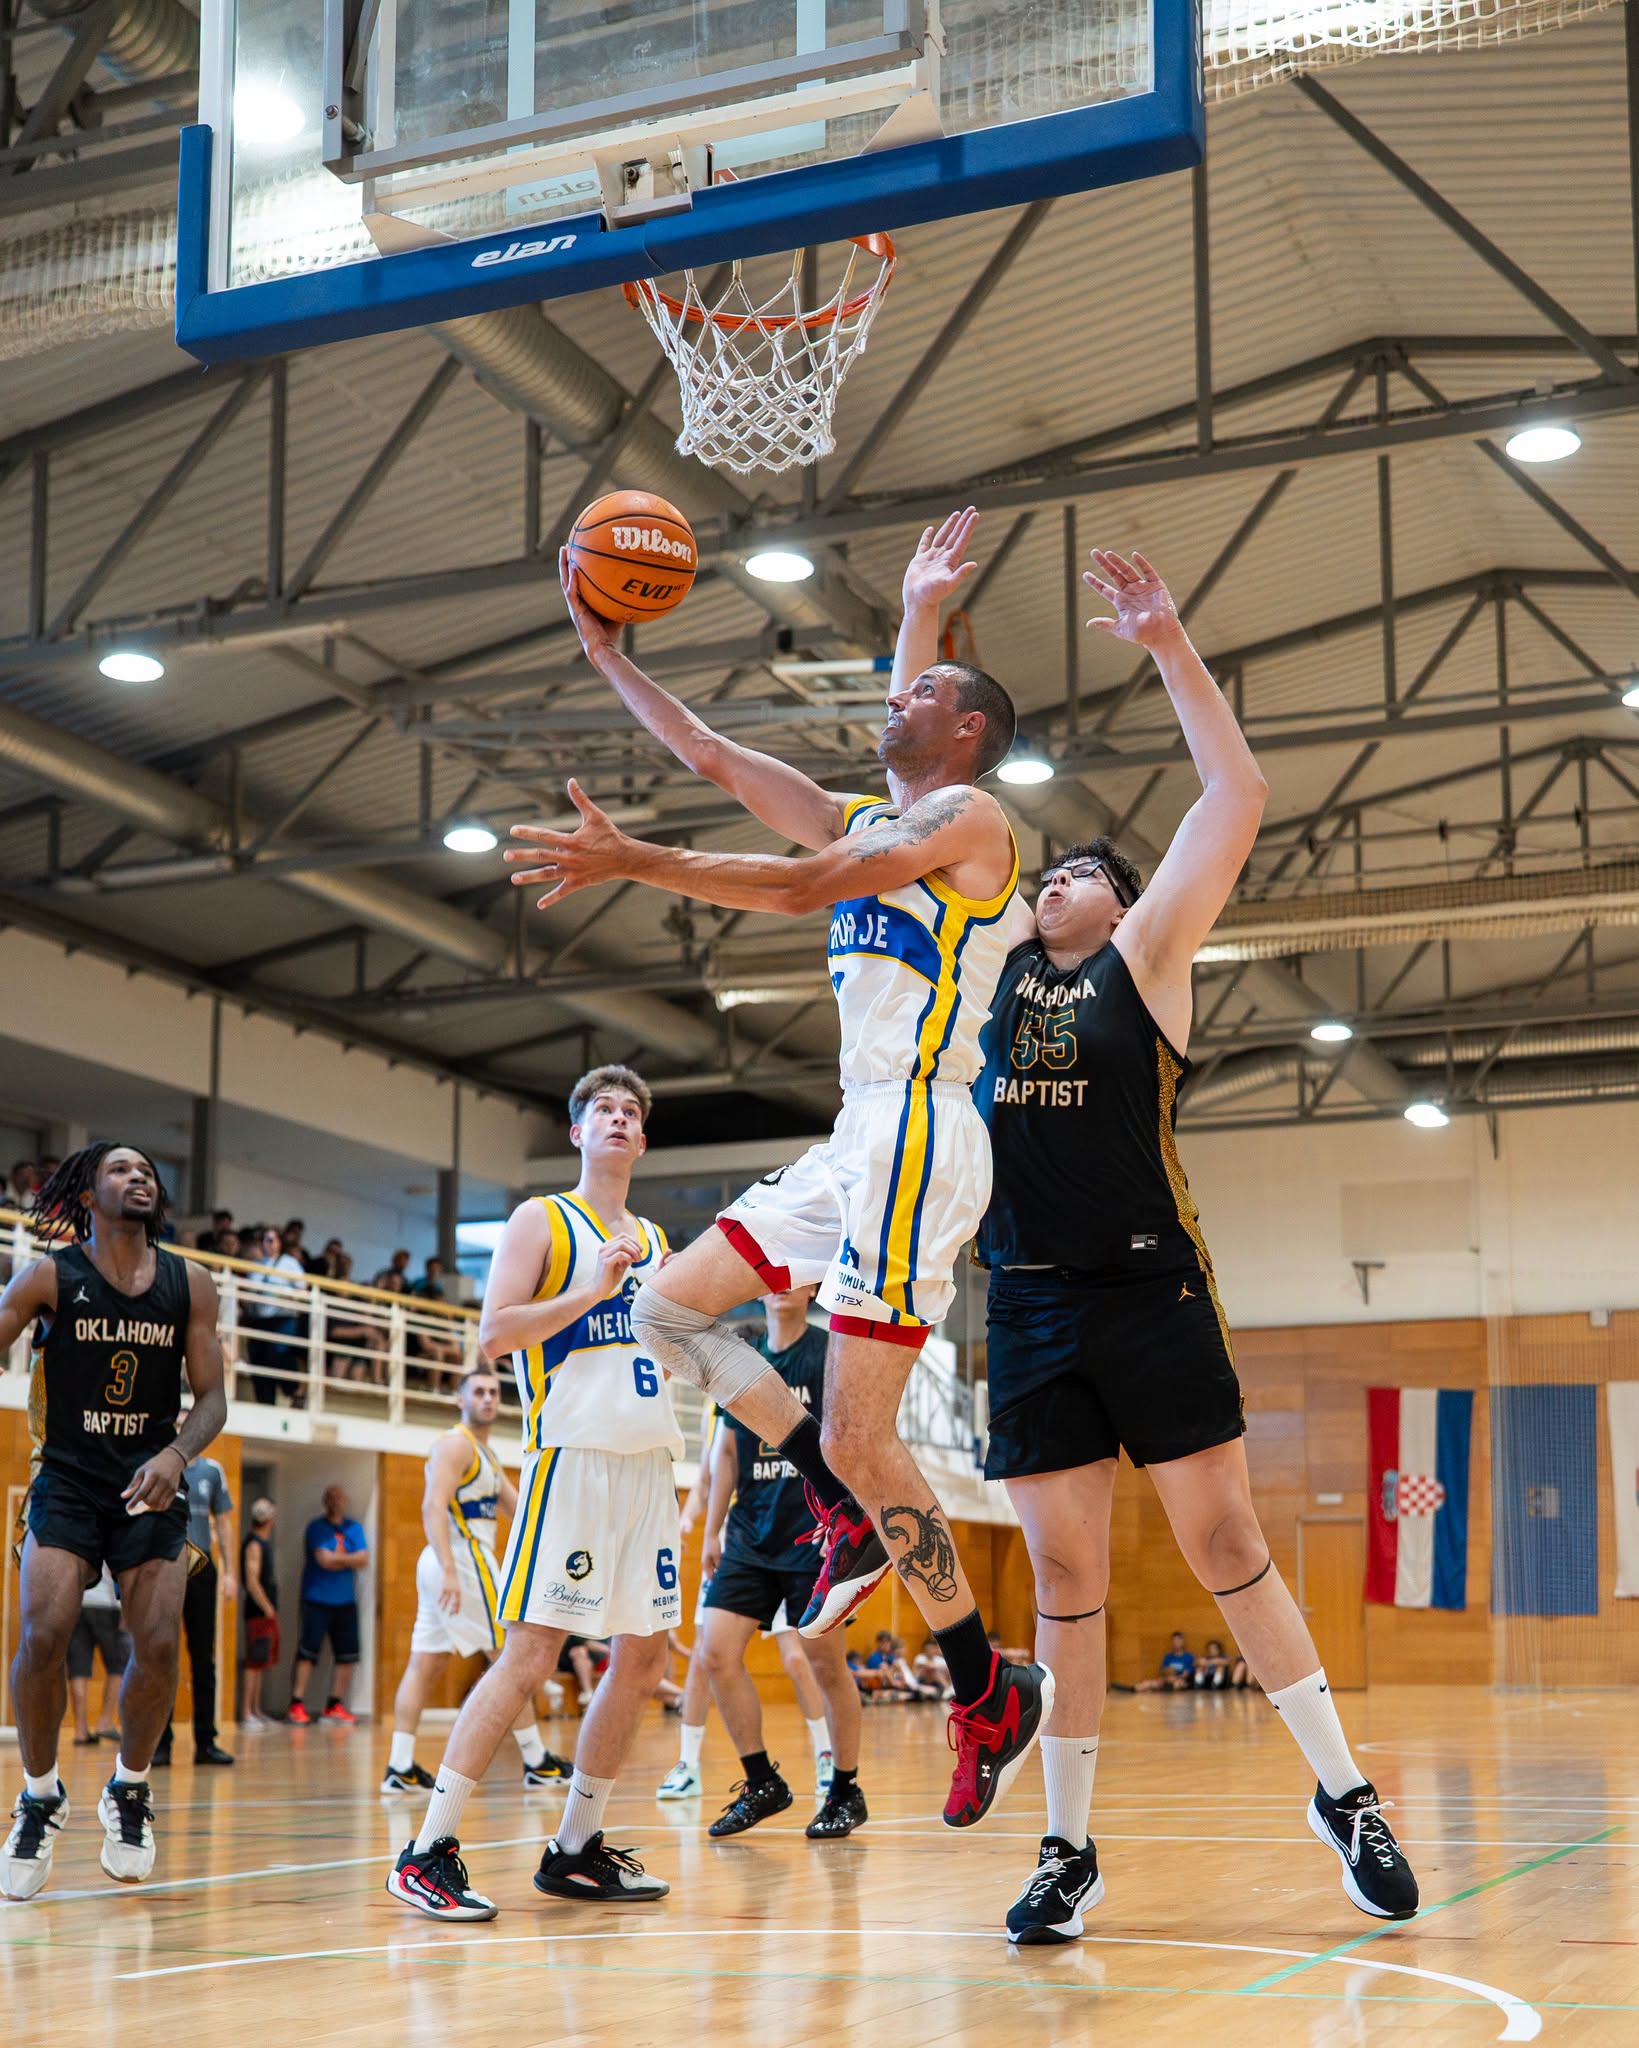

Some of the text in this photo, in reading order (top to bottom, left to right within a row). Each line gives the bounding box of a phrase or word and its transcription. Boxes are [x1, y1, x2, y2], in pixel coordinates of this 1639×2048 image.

[471, 234, 577, 268] elan
[612, 526, 692, 563] Wilson
[621, 578, 673, 600] EVO
[1010, 1008, 1077, 1070] 55
[993, 1076, 1089, 1107] BAPTIST
[75, 1318, 175, 1348] OKLAHOMA
[105, 1350, 138, 1406] 3
[632, 1356, 659, 1397] 6
[83, 1410, 149, 1436] BAPTIST
[753, 1460, 804, 1480] BAPTIS
[656, 1547, 677, 1590] 6
